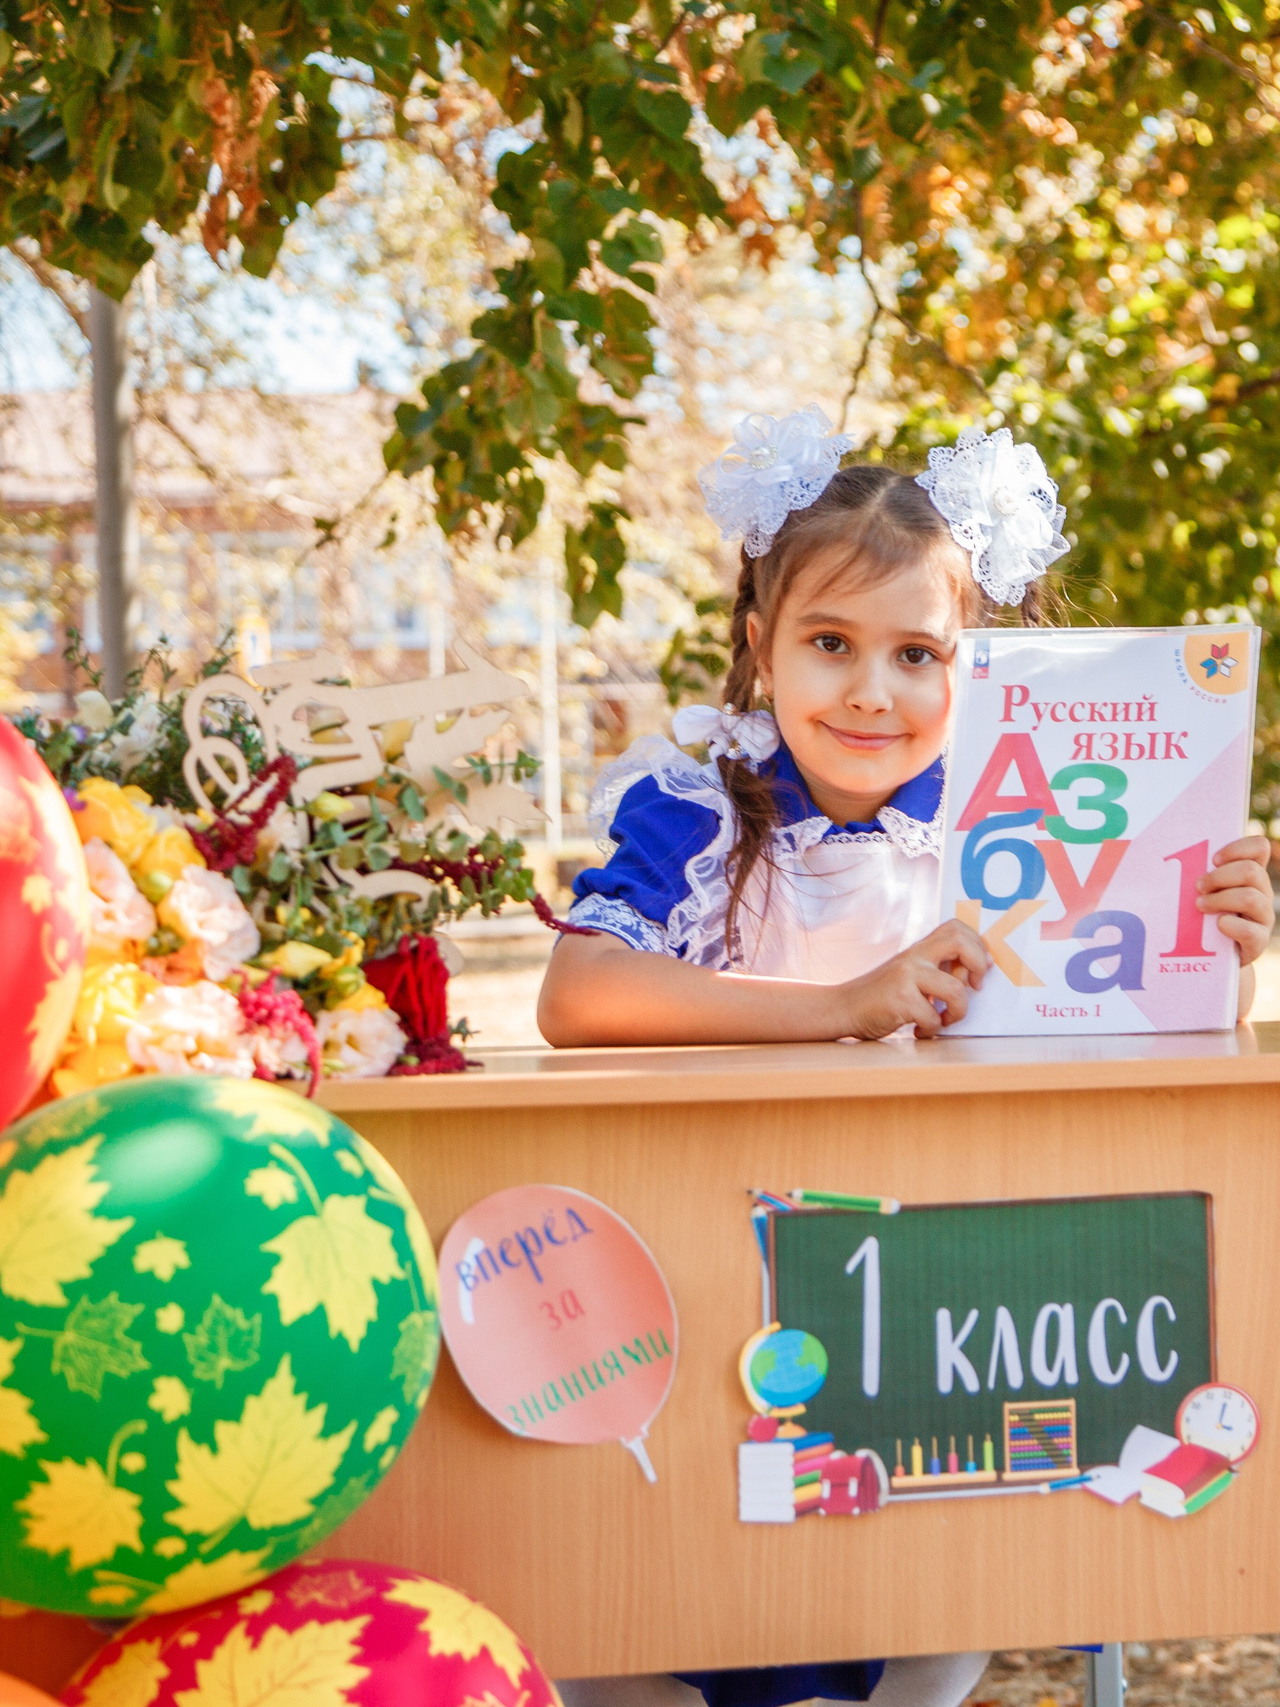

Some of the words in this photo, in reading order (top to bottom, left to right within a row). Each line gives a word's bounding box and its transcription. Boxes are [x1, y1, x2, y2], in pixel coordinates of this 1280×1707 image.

[998, 684, 1158, 731] Русский
[1159, 838, 1216, 958] 1
[1159, 962, 1212, 973] класс
[1035, 1004, 1088, 1018] Часть
[1094, 1004, 1101, 1017] 1
[539, 1289, 585, 1331] за
[845, 1235, 882, 1398] 1
[936, 1295, 1179, 1394] класс
[504, 1328, 672, 1436] знаниями
